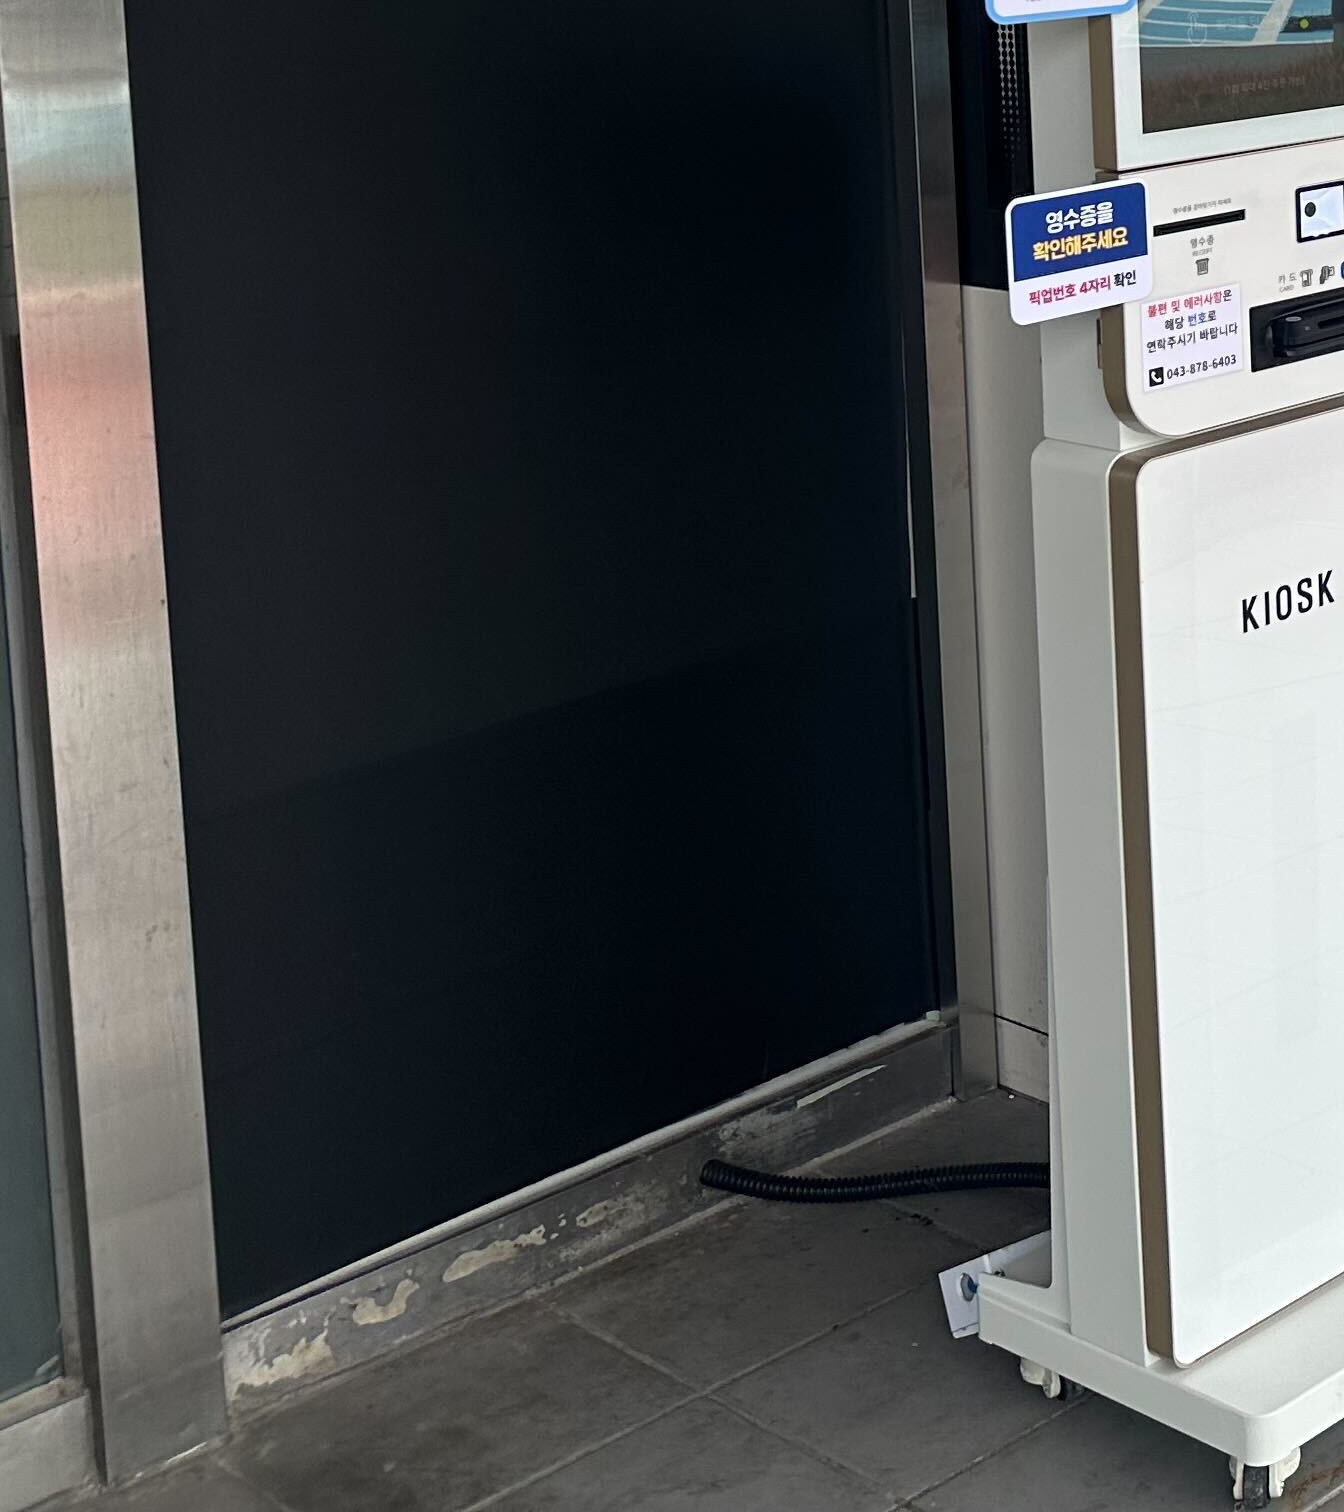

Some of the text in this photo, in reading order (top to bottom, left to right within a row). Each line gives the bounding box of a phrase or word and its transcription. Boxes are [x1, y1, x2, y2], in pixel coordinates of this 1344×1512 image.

[1045, 201, 1114, 233] 영수증을
[1032, 226, 1129, 262] 확인해주세요
[1028, 269, 1137, 305] 픽업번호 4자리 확인
[1147, 289, 1233, 318] 불편 및 에러사항은
[1164, 309, 1217, 331] 해당 번호로
[1146, 321, 1239, 355] 연락주시기 바랍니다
[1166, 354, 1237, 380] 043-878-6403
[1240, 568, 1336, 634] KIOSK
